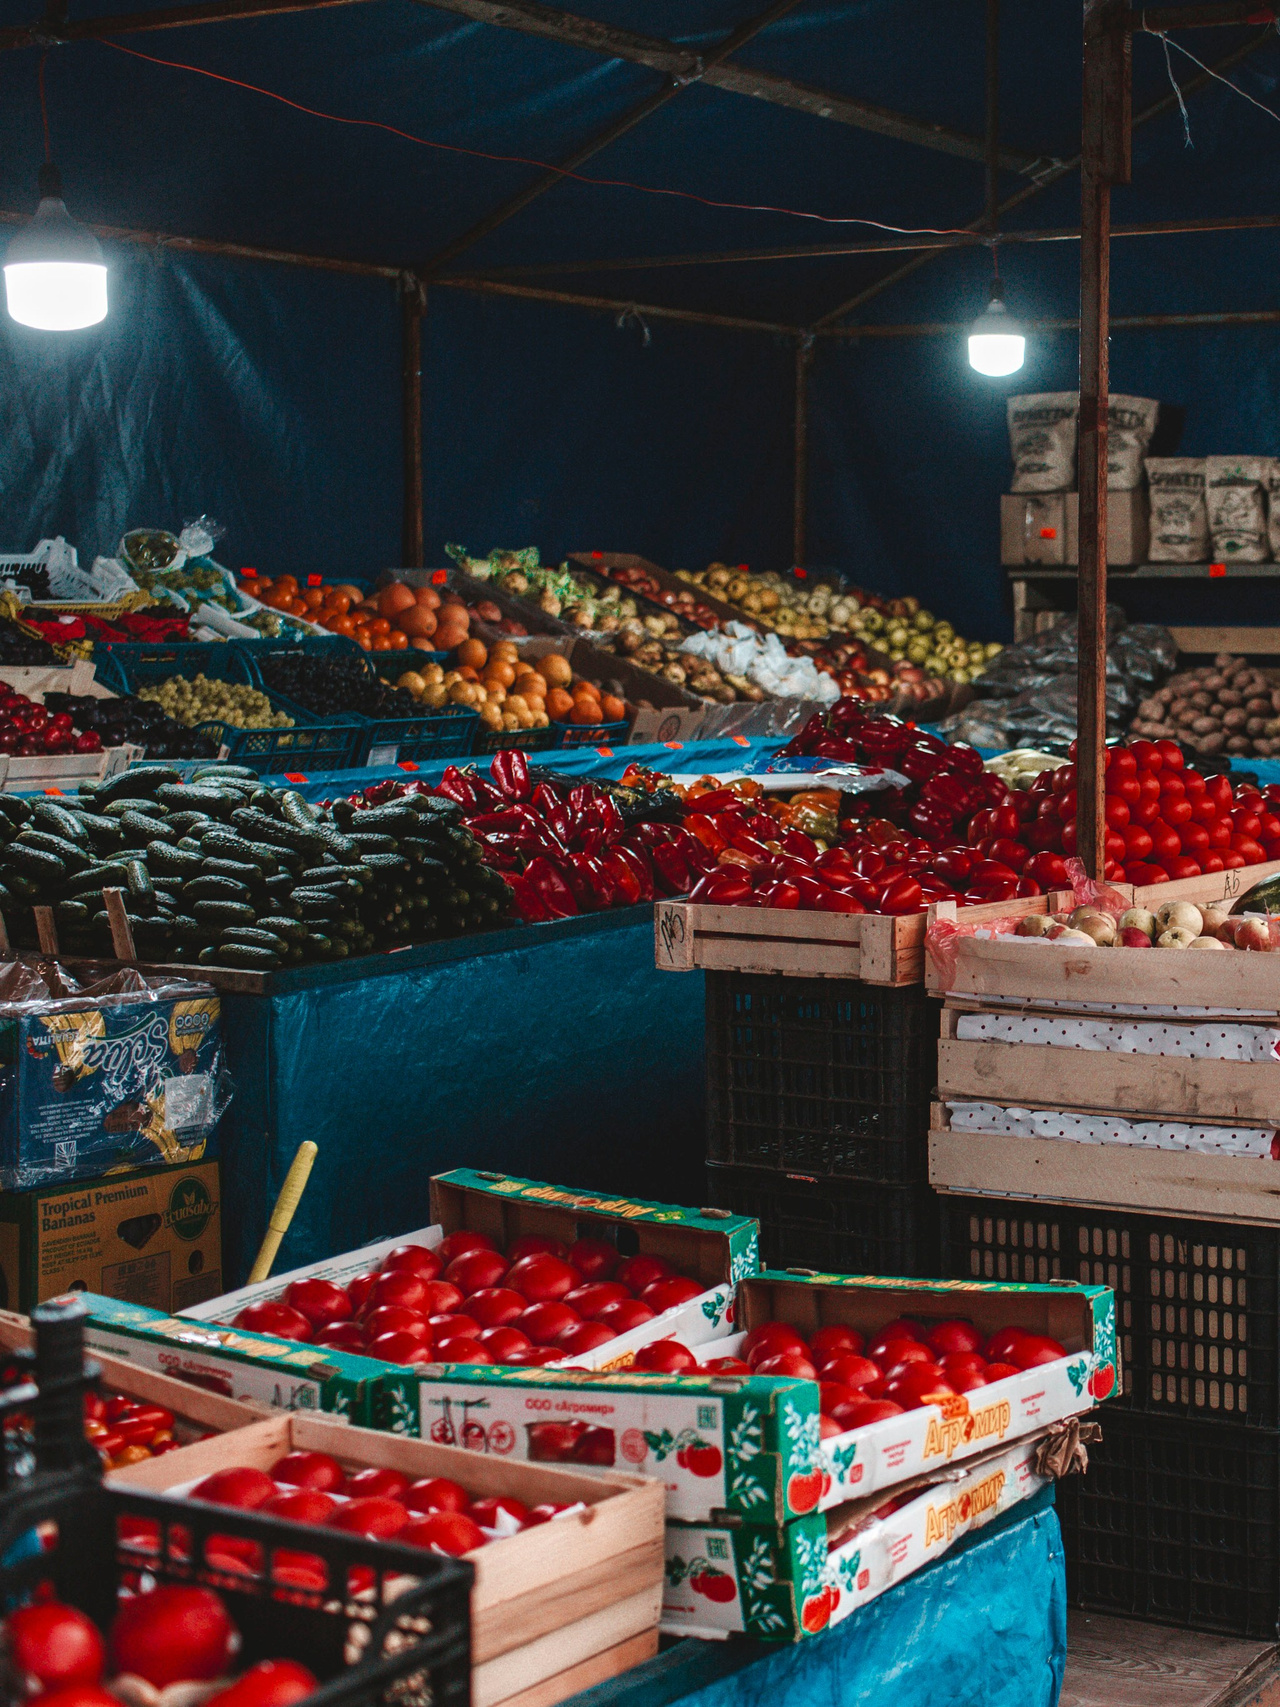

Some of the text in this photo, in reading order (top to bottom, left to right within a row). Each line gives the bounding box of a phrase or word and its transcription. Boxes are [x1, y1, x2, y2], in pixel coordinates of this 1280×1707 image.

[41, 1185, 149, 1217] Tropical Premium
[161, 1199, 219, 1228] Ecuasabor
[42, 1212, 96, 1232] Bananas
[525, 1399, 551, 1411] ООО
[923, 1399, 1011, 1460] Агромир
[925, 1469, 1006, 1548] Агромир
